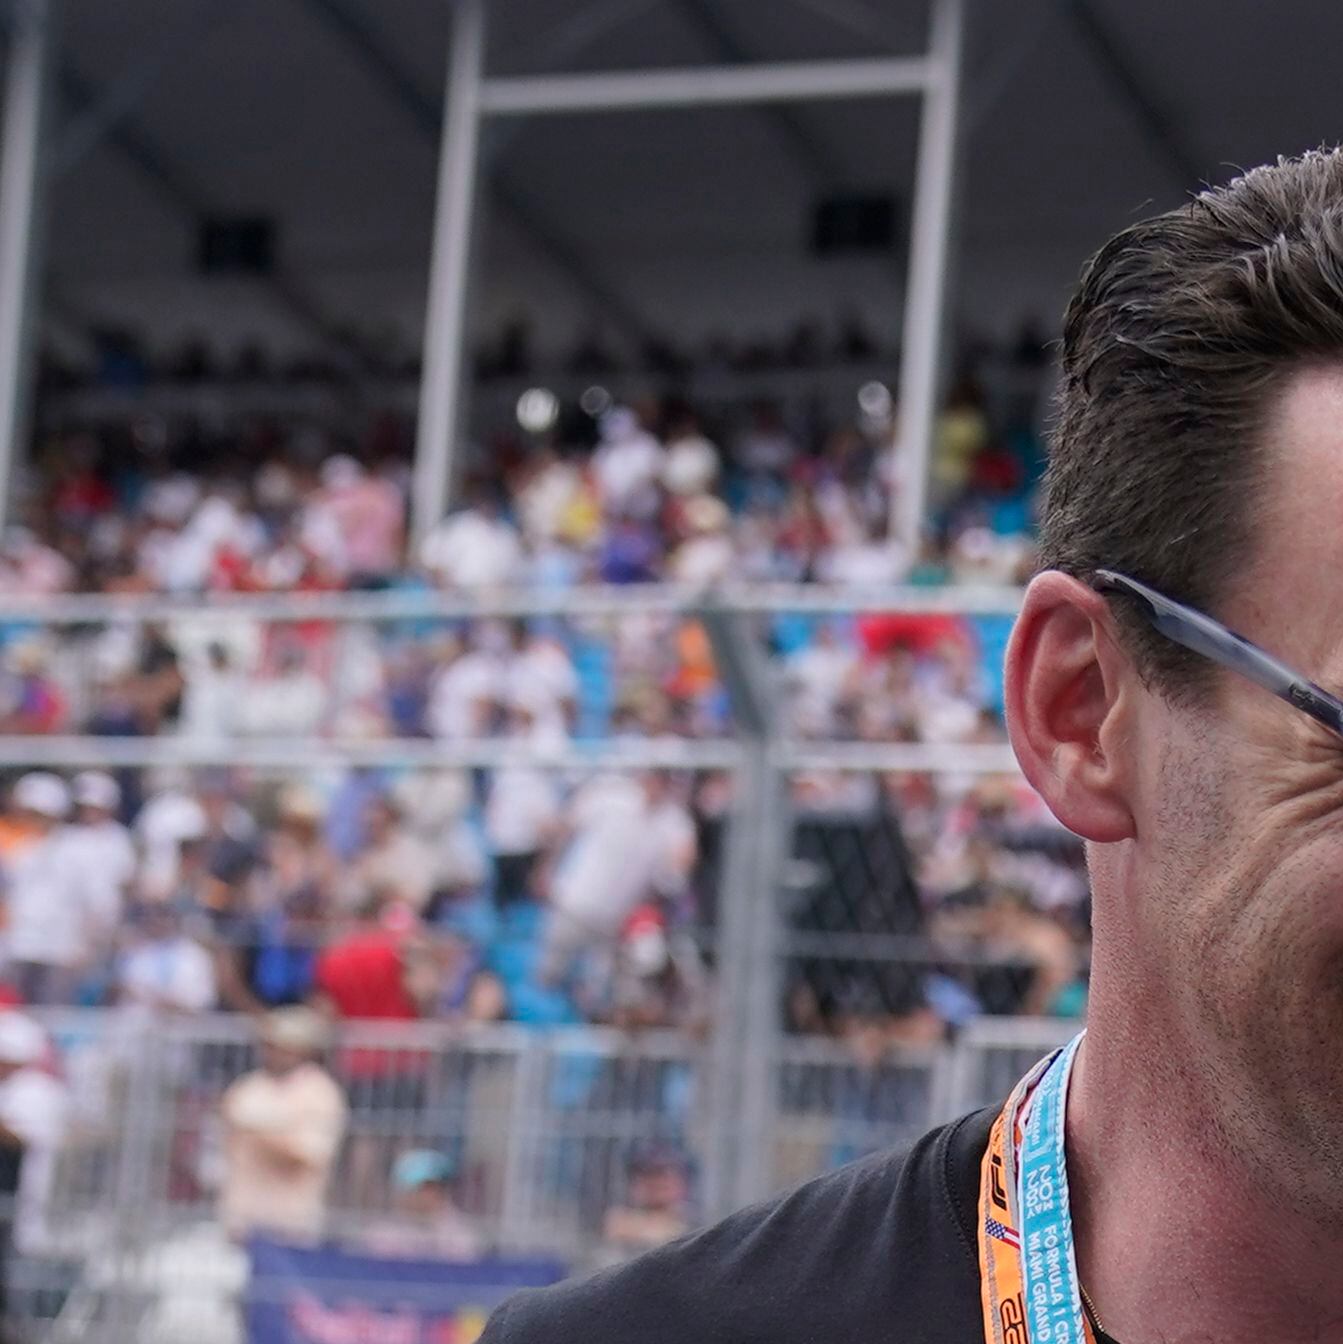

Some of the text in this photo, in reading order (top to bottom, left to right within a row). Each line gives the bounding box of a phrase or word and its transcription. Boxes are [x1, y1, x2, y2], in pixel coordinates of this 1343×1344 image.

[1027, 1164, 1052, 1190] 22
[1026, 1183, 1054, 1208] 08
[1027, 1200, 1054, 1219] MAY
[1027, 1231, 1044, 1282] MIAMI
[1043, 1222, 1066, 1305] FORMULA
[1032, 1283, 1052, 1343] GRAND
[1053, 1307, 1063, 1317] 1
